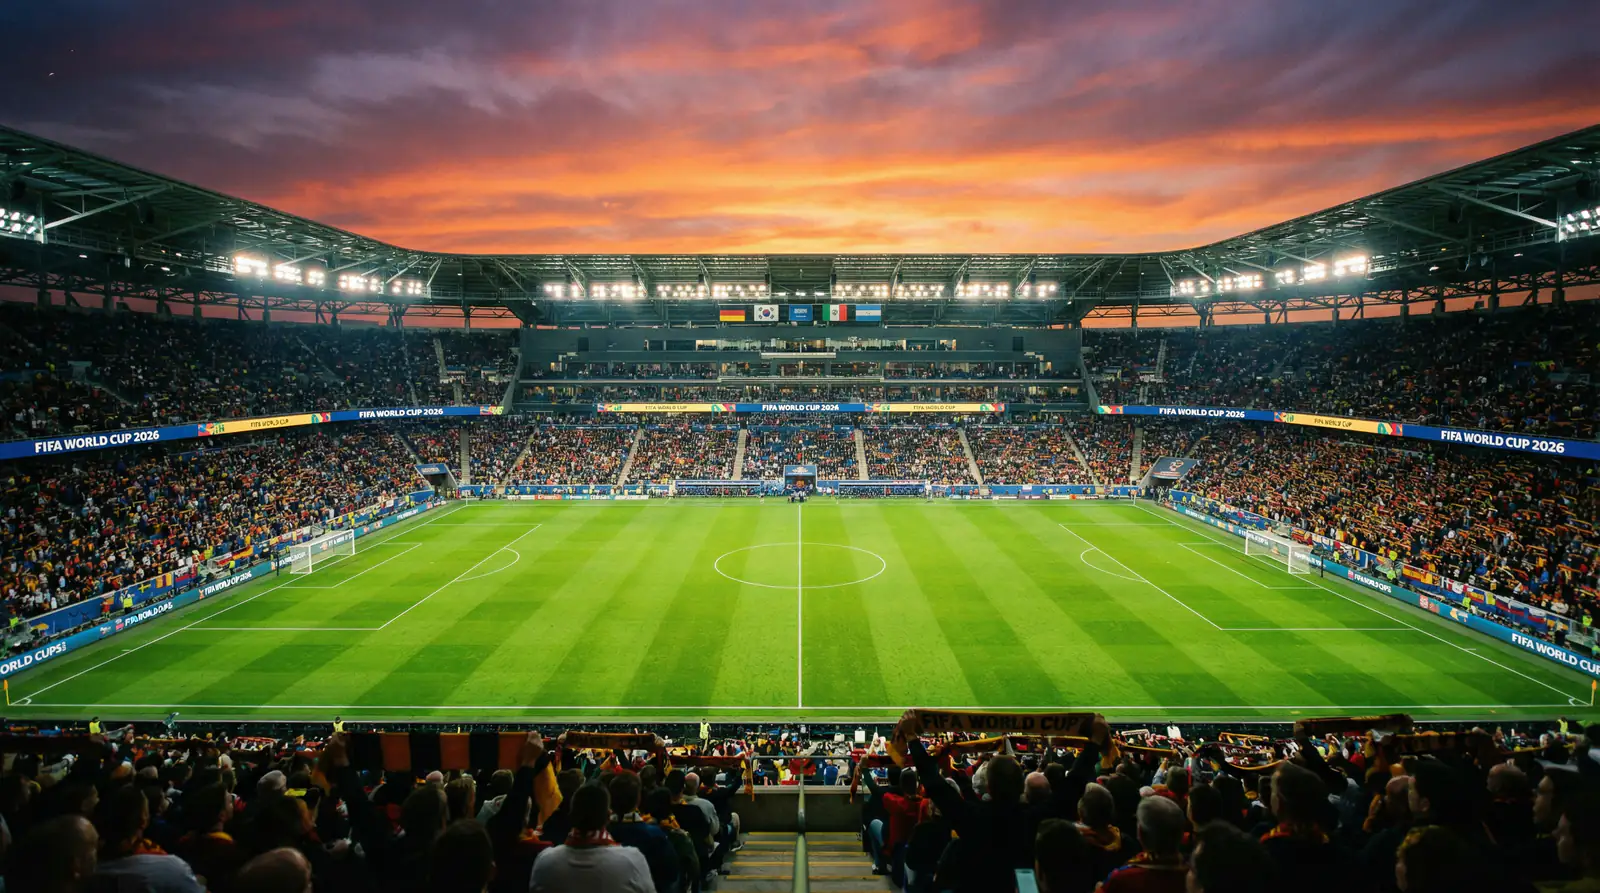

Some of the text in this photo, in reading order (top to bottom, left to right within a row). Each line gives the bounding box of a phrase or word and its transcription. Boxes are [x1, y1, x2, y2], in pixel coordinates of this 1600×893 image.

[376, 409, 405, 418] WORLD
[406, 409, 422, 417] CUP
[423, 408, 444, 416] 2026
[1159, 407, 1245, 418] FIFA WORLD CUP 2026
[34, 430, 160, 453] FIFA WORLD CUP 2026
[1440, 430, 1565, 453] FIFA WORLD CUP 2026
[1511, 632, 1535, 650] FIFA
[1535, 641, 1578, 666] WORLD
[921, 713, 1079, 731] FIFA WORLD CUP
